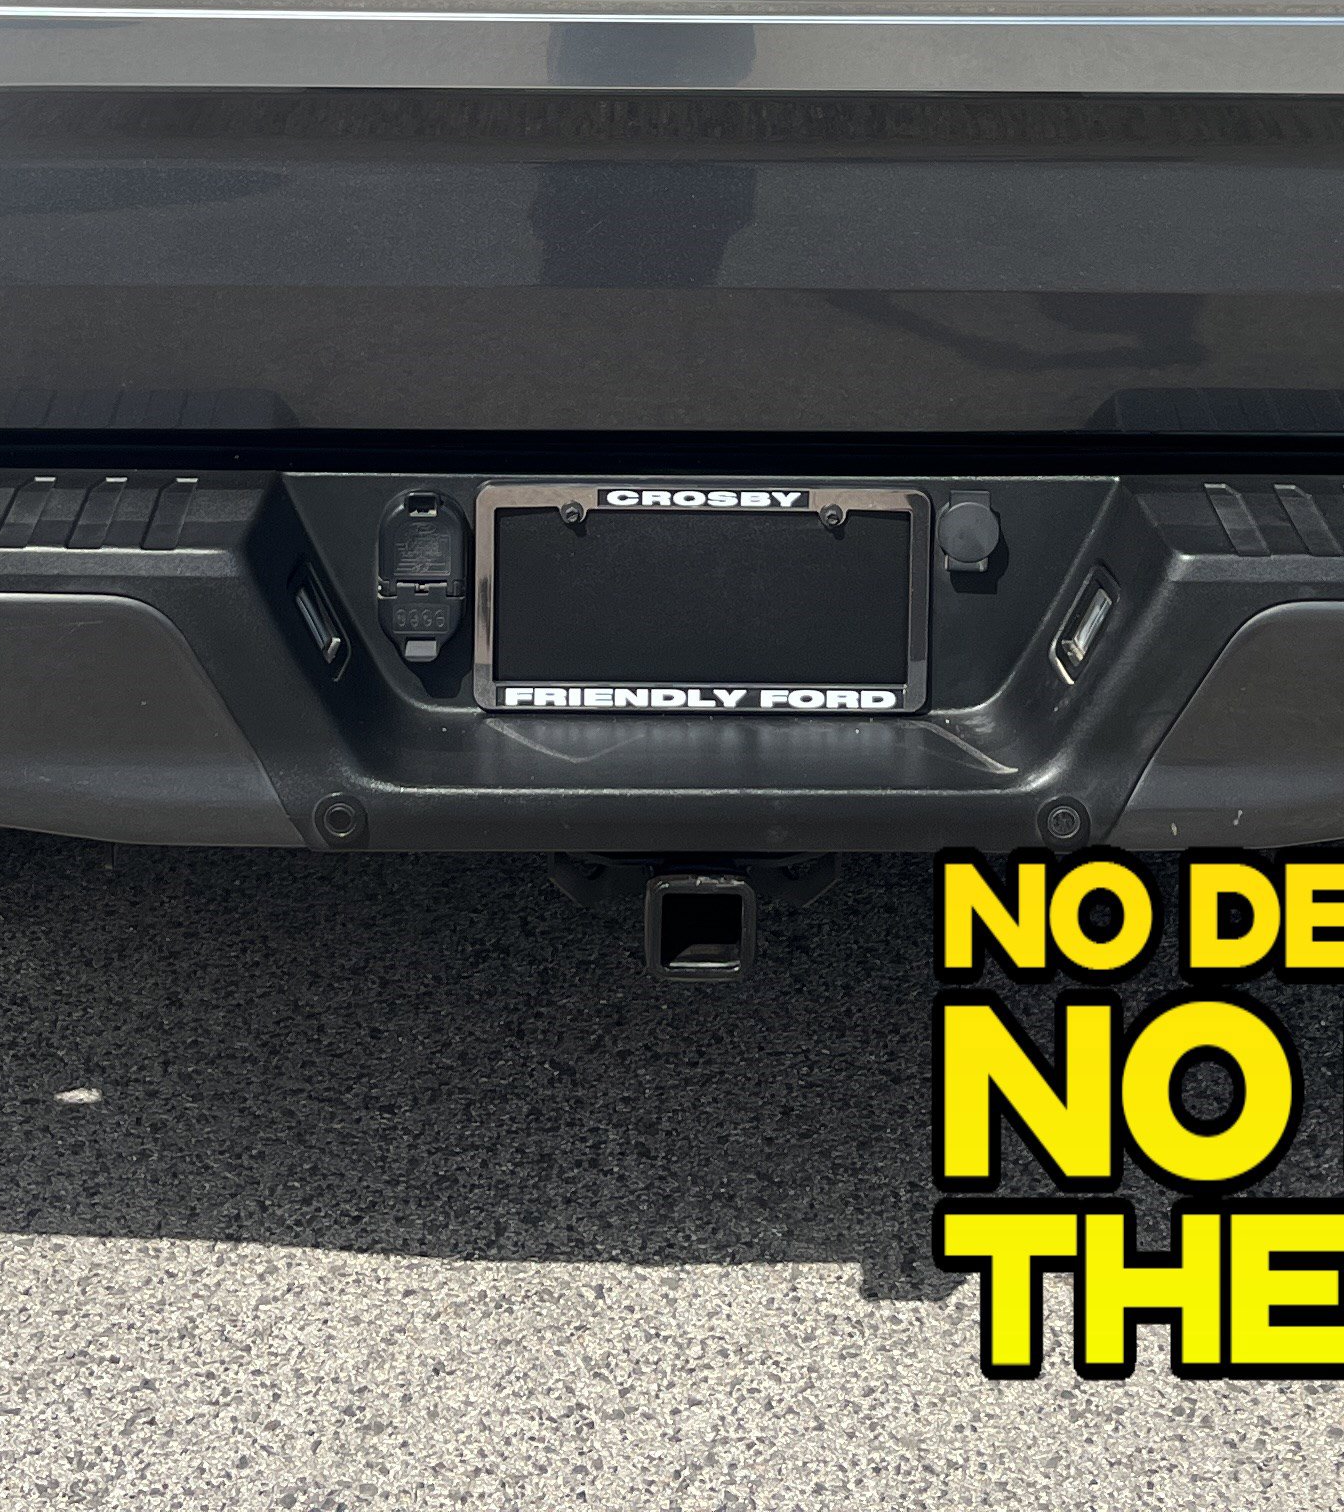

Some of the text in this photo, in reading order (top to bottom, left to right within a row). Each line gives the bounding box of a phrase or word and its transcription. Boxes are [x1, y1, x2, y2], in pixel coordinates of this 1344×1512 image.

[606, 490, 802, 508] CROSBY
[504, 687, 897, 709] FRIENDLY FORD
